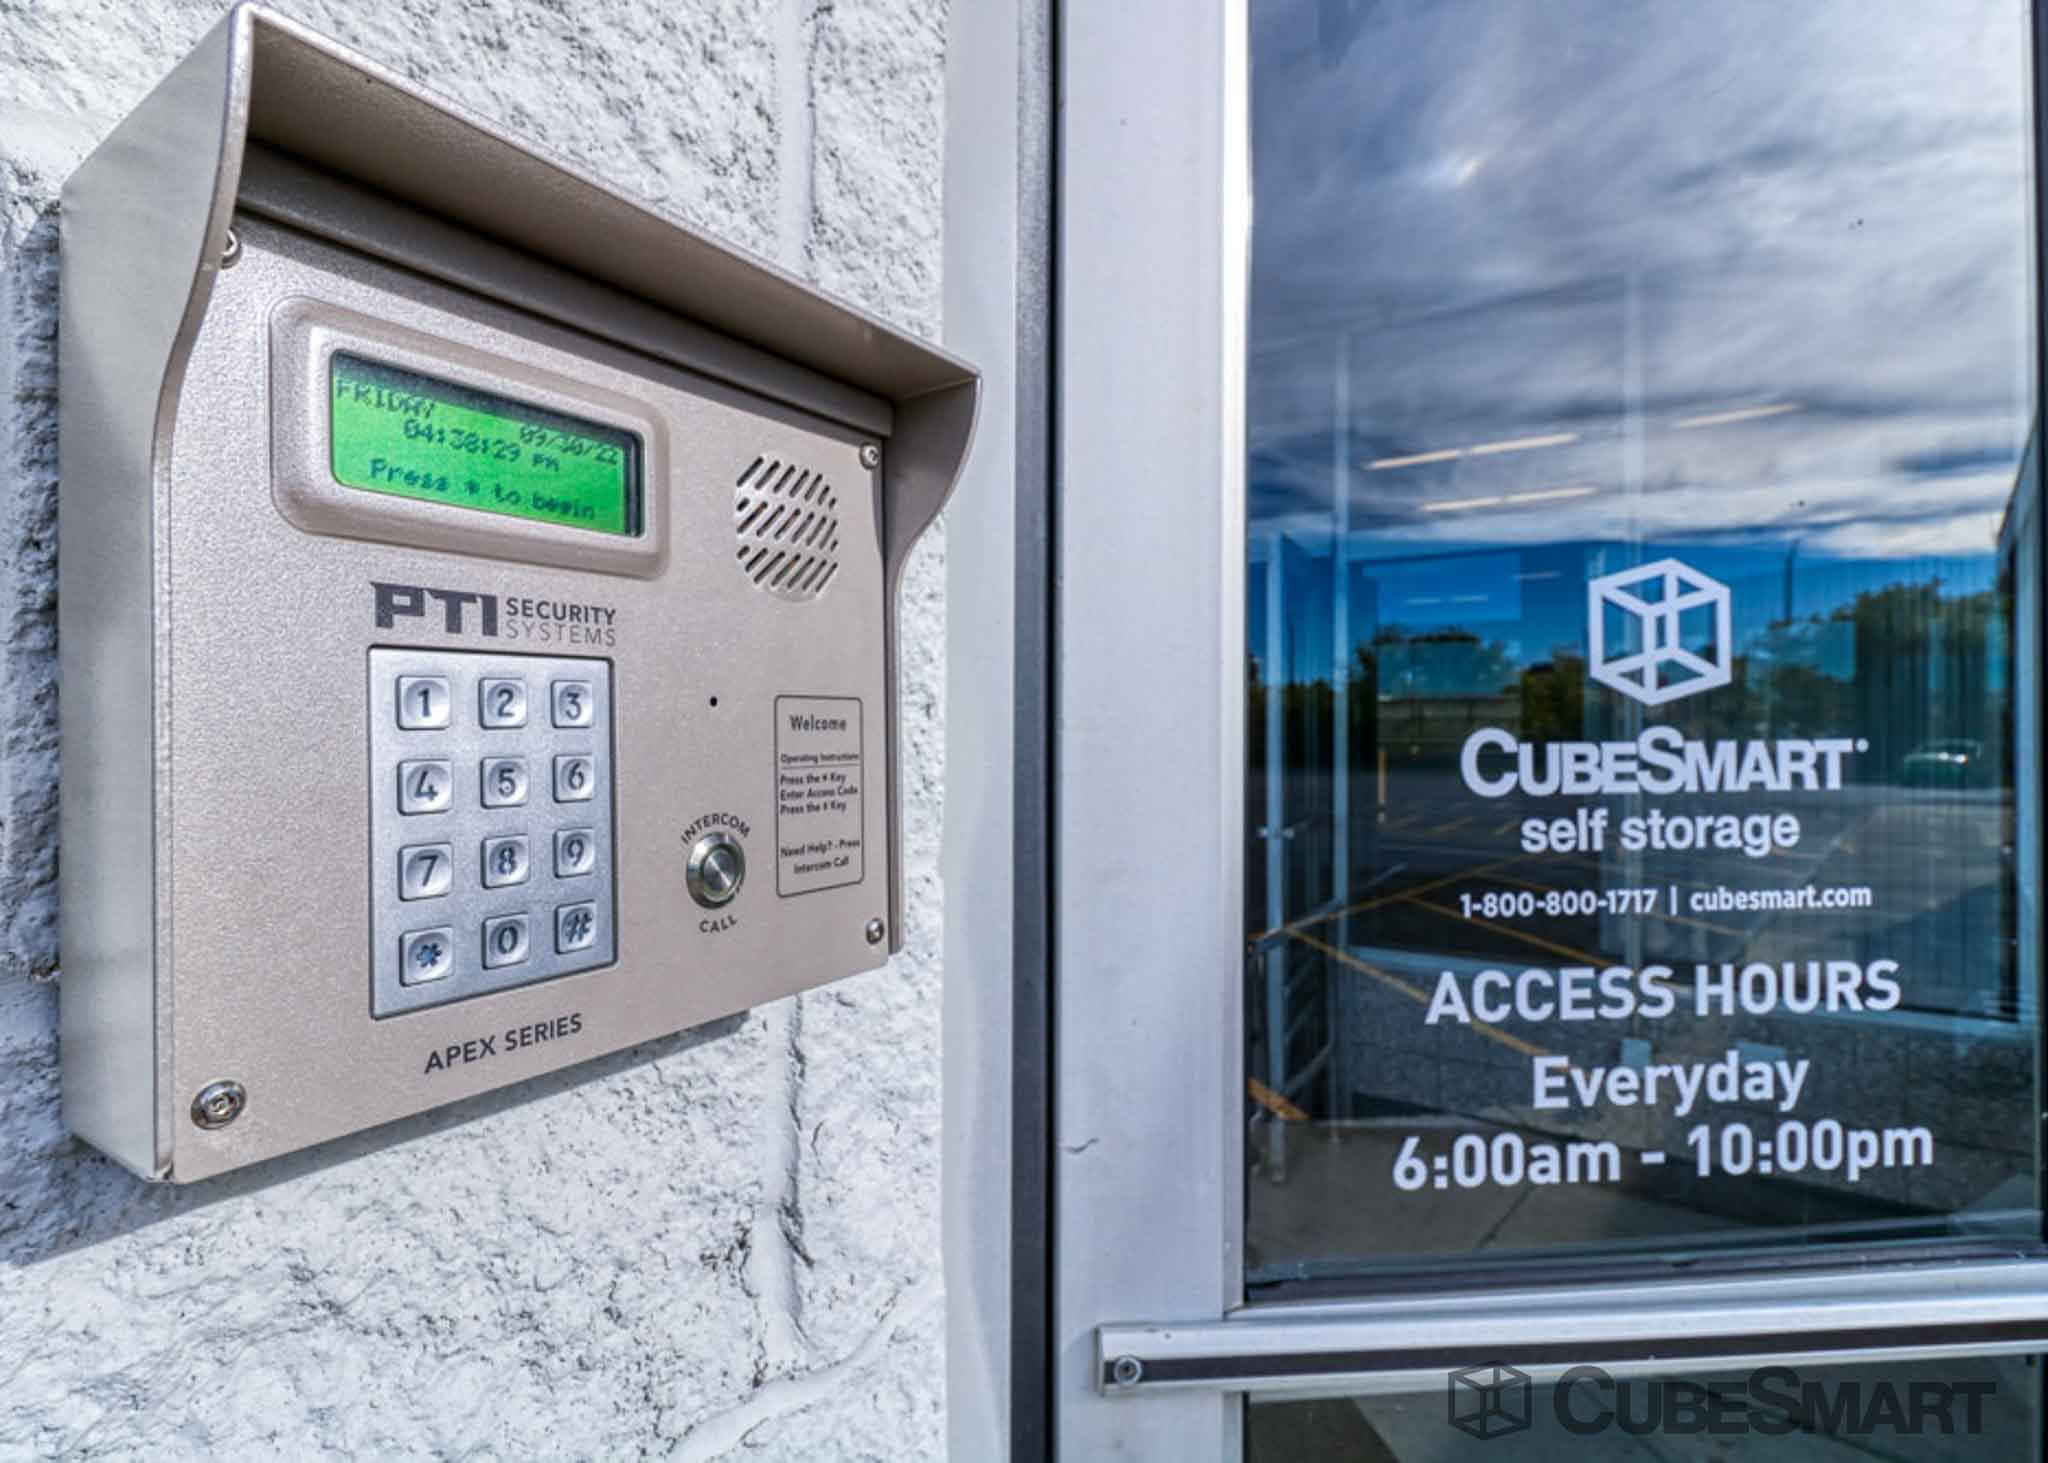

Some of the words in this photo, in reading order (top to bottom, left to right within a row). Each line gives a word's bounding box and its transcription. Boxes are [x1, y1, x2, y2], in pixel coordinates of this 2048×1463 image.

[336, 378, 434, 418] FRIDAY
[403, 419, 521, 462] 04:38:29
[369, 457, 448, 492] Press
[494, 482, 521, 506] to
[532, 491, 595, 521] begin
[370, 582, 498, 637] PTI
[506, 598, 616, 626] SECURITY
[505, 618, 616, 648] SYSTEMS
[416, 688, 432, 717] 1
[496, 689, 515, 718] 2
[565, 692, 582, 720] 3
[788, 713, 847, 732] Welcome
[413, 770, 438, 801] 4
[497, 767, 517, 797] 5
[568, 762, 585, 790] 6
[780, 774, 804, 785] Press
[806, 773, 821, 784] the
[780, 788, 804, 800] Enter
[806, 787, 835, 798] Access
[837, 784, 859, 796] Code
[780, 804, 804, 816] Press
[806, 802, 821, 813] the
[680, 812, 751, 845] INTERCOM
[1520, 808, 1610, 853] self
[1619, 810, 1801, 858] storage
[418, 855, 439, 887] 7
[499, 846, 517, 876] 8
[567, 838, 585, 867] 9
[780, 844, 806, 857] Need
[793, 860, 833, 875] Intercom
[833, 856, 850, 867] Call
[1459, 888, 1659, 918] 1-800-800-1717
[1689, 885, 1873, 912] cubesmart.com
[498, 925, 519, 954] 0
[699, 914, 738, 934] CALL
[1424, 966, 1676, 1026] ACCESS
[1694, 959, 1902, 1016] HOURS
[423, 1036, 497, 1075] APEX
[504, 1013, 583, 1052] SERIES
[1532, 1049, 1810, 1117] Everyday
[1392, 1132, 1622, 1191] 6:00am
[1686, 1118, 1934, 1183] 10:00pm
